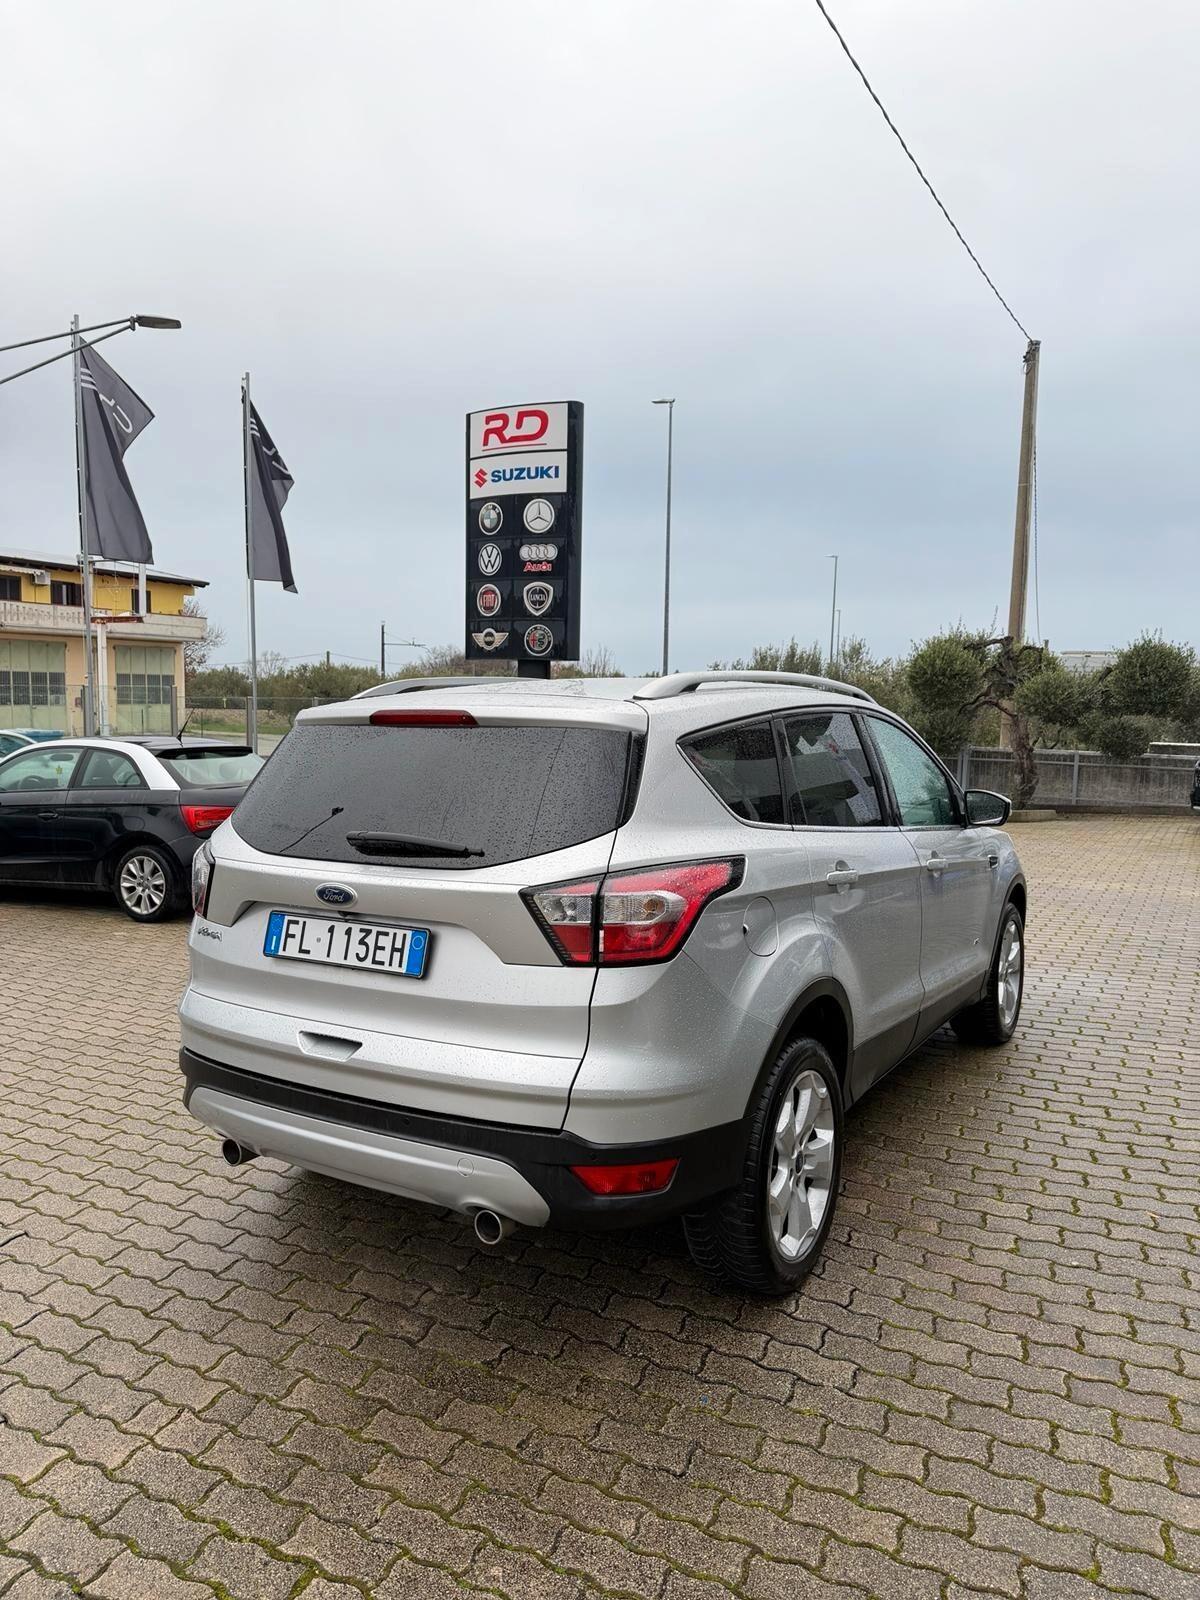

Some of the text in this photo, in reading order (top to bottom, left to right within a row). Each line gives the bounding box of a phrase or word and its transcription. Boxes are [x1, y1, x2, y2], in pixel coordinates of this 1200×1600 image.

[483, 409, 549, 447] RD
[491, 465, 560, 483] SUZUKI
[523, 561, 552, 572] Audi
[324, 888, 345, 902] Ford
[283, 919, 311, 955] FL
[326, 924, 407, 968] 113EH
